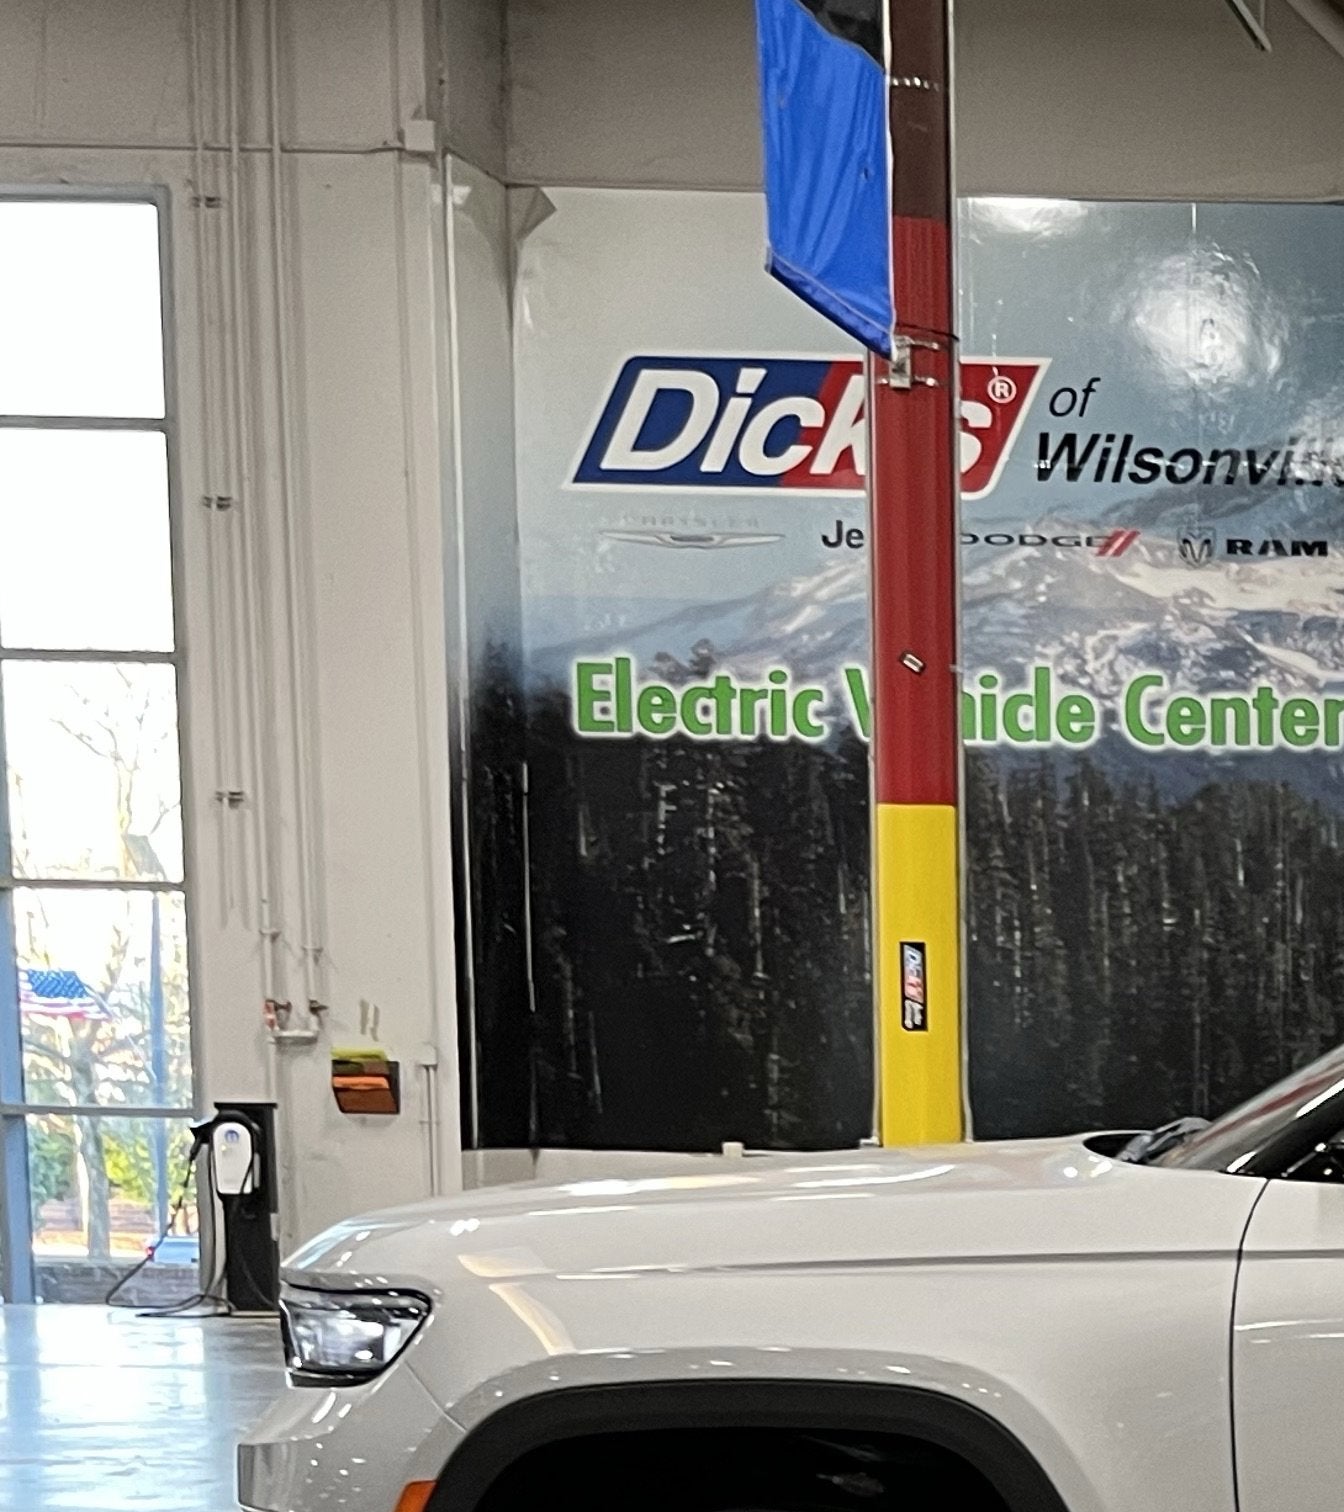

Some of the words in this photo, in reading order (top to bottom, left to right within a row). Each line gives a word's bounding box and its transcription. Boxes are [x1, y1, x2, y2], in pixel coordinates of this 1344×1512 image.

[1049, 377, 1101, 418] of
[1226, 538, 1328, 557] RAM
[576, 657, 825, 738] Electric
